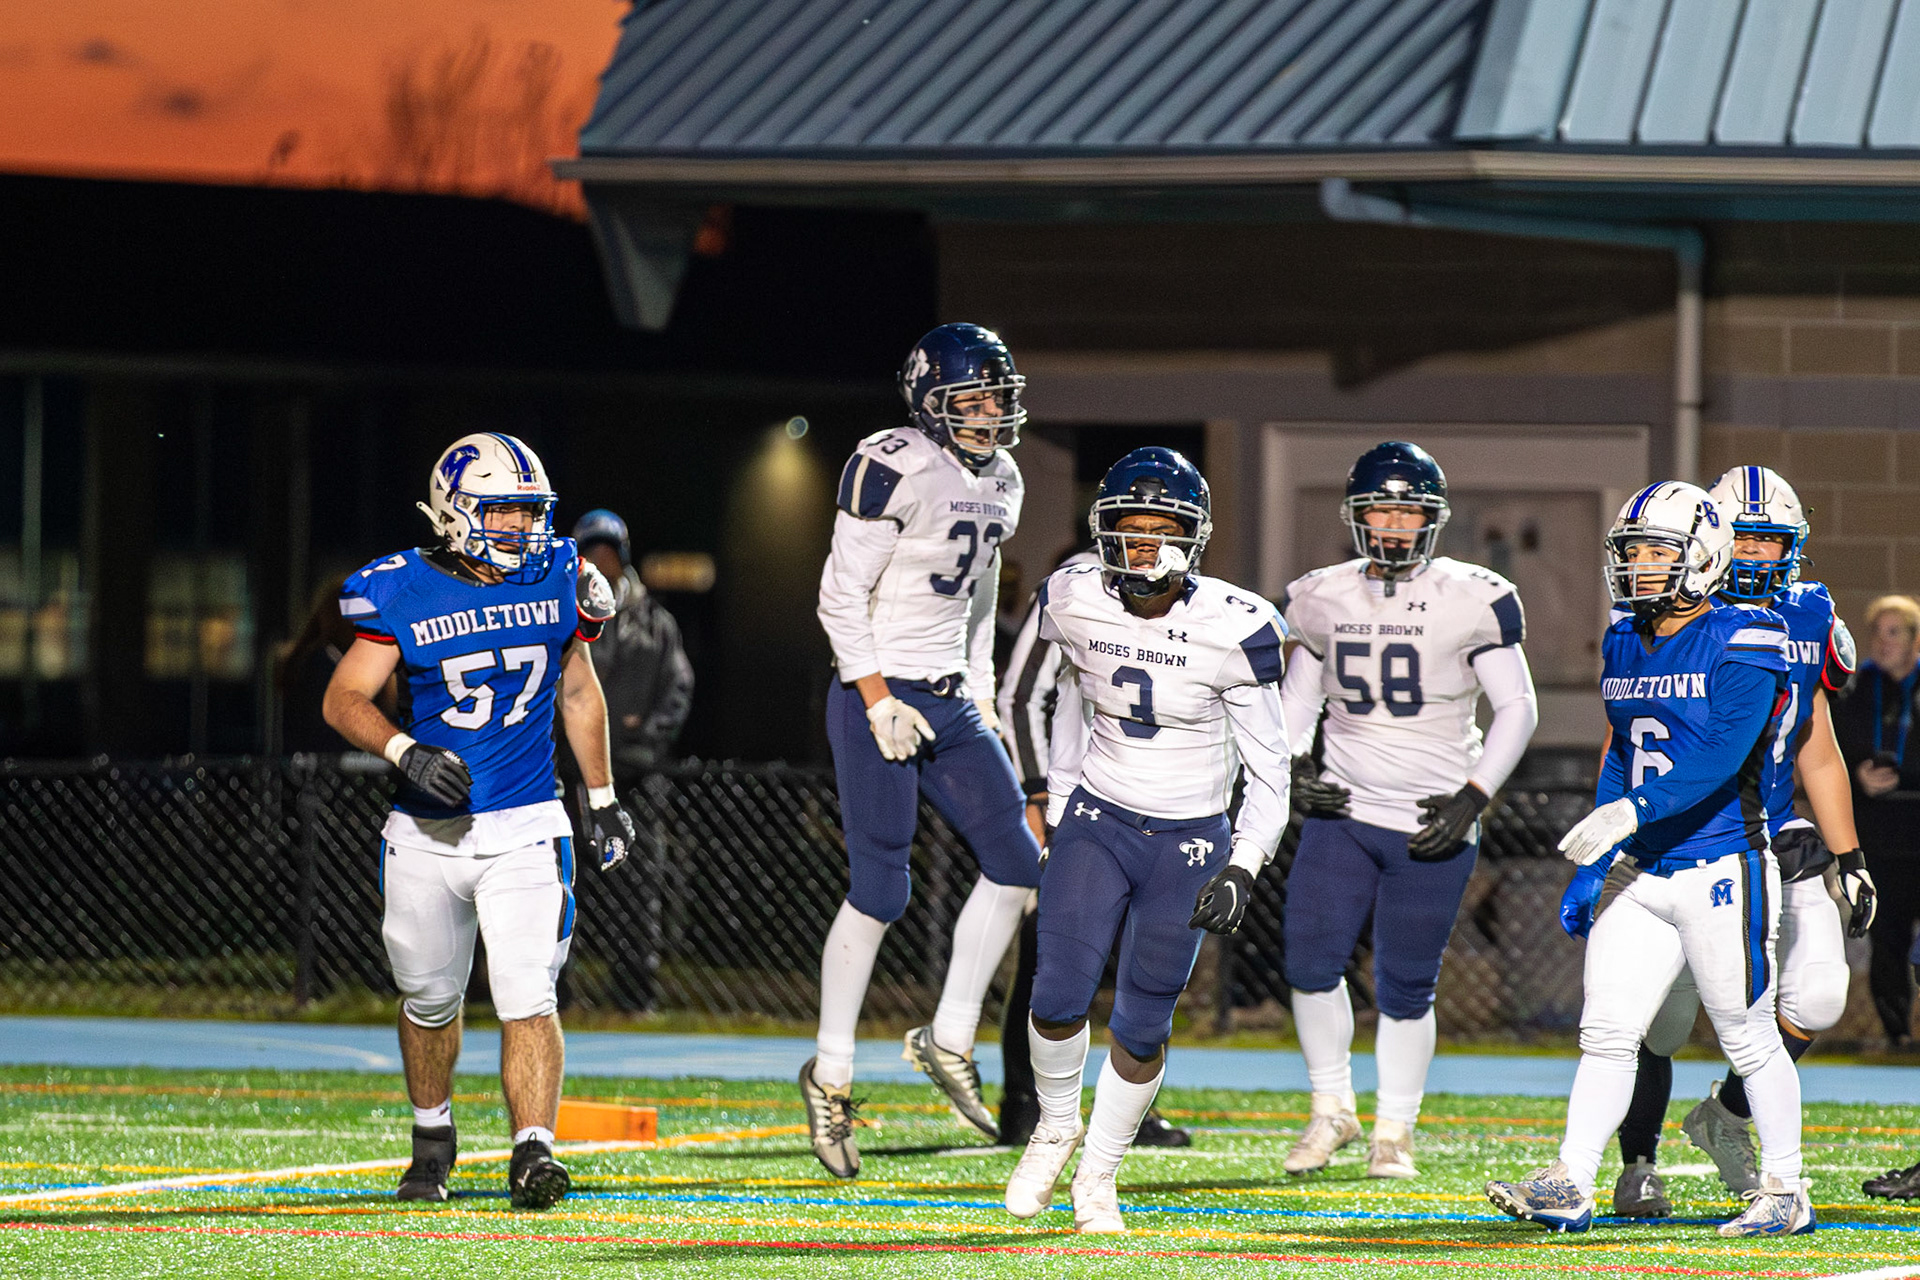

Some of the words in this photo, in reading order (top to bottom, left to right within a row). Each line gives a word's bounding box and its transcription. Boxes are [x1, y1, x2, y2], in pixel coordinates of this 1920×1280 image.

[410, 599, 560, 646] MIDDLETOWN
[1088, 639, 1130, 658] MOSES
[1136, 649, 1187, 667] BROWN
[1334, 623, 1373, 635] MOSES
[1378, 625, 1424, 636] BROWN
[440, 643, 549, 731] 57
[1111, 665, 1162, 740] 3
[1335, 641, 1423, 717] 58
[1630, 716, 1674, 790] 6
